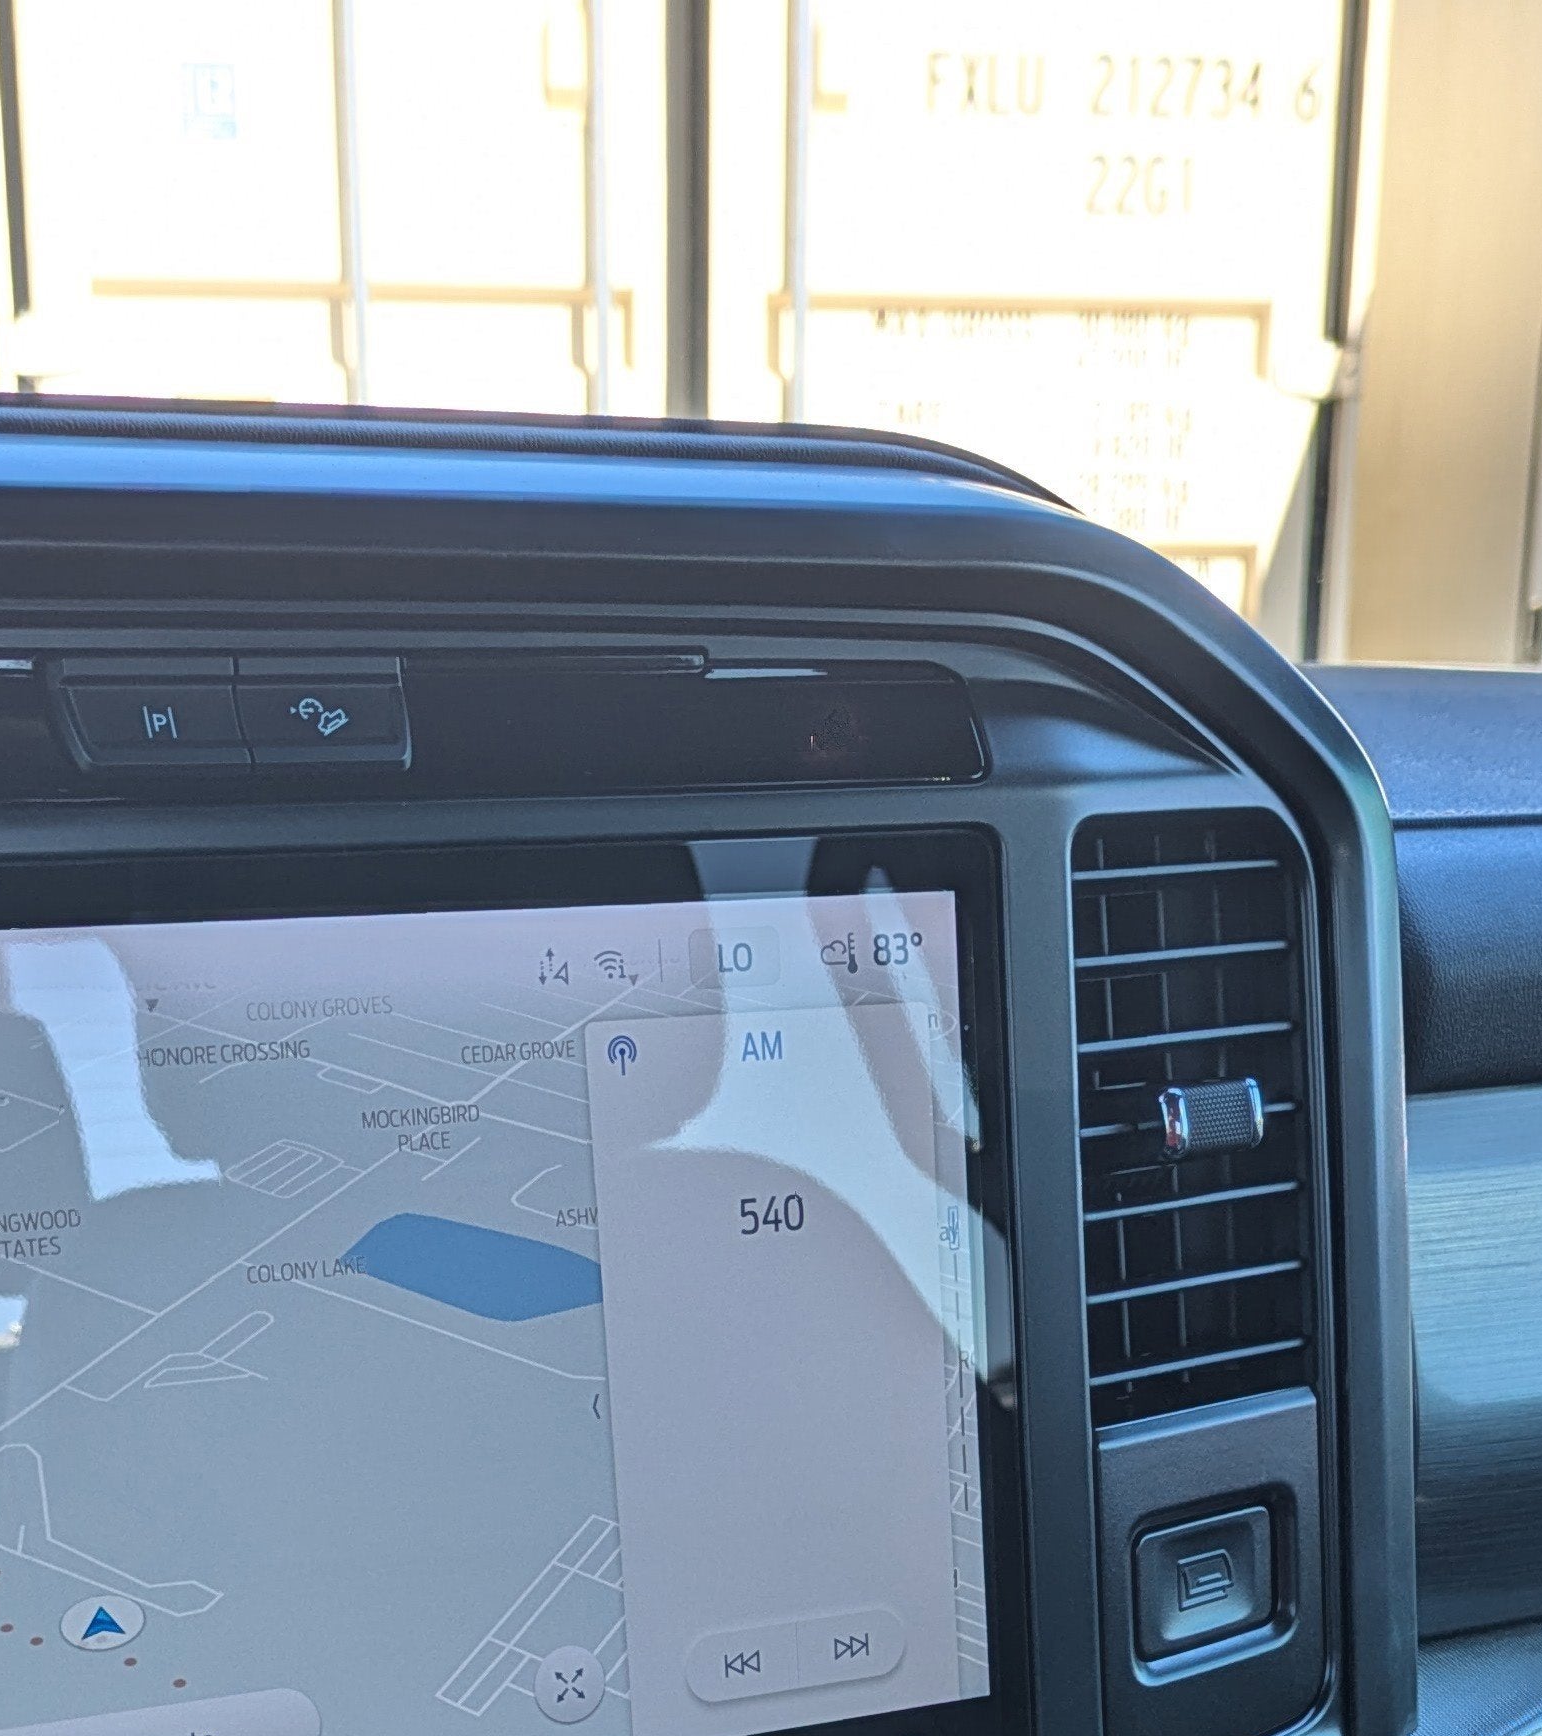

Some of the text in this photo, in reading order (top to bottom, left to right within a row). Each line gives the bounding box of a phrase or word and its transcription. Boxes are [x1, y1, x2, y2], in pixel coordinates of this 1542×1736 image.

[925, 52, 1322, 122] FXLU 212734 6
[1085, 154, 1194, 217] 22G1
[717, 931, 924, 973] LO 83°
[246, 995, 394, 1023] COLONY GROVES
[138, 1039, 311, 1068] HONORE CROSSING
[460, 1039, 577, 1065] CEDAR GROVE
[741, 1031, 784, 1062] AM
[362, 1103, 481, 1130] MOCKINGBIRD
[397, 1131, 451, 1153] PLACE
[739, 1193, 806, 1236] 540
[247, 1256, 367, 1285] COLONY LAKE
